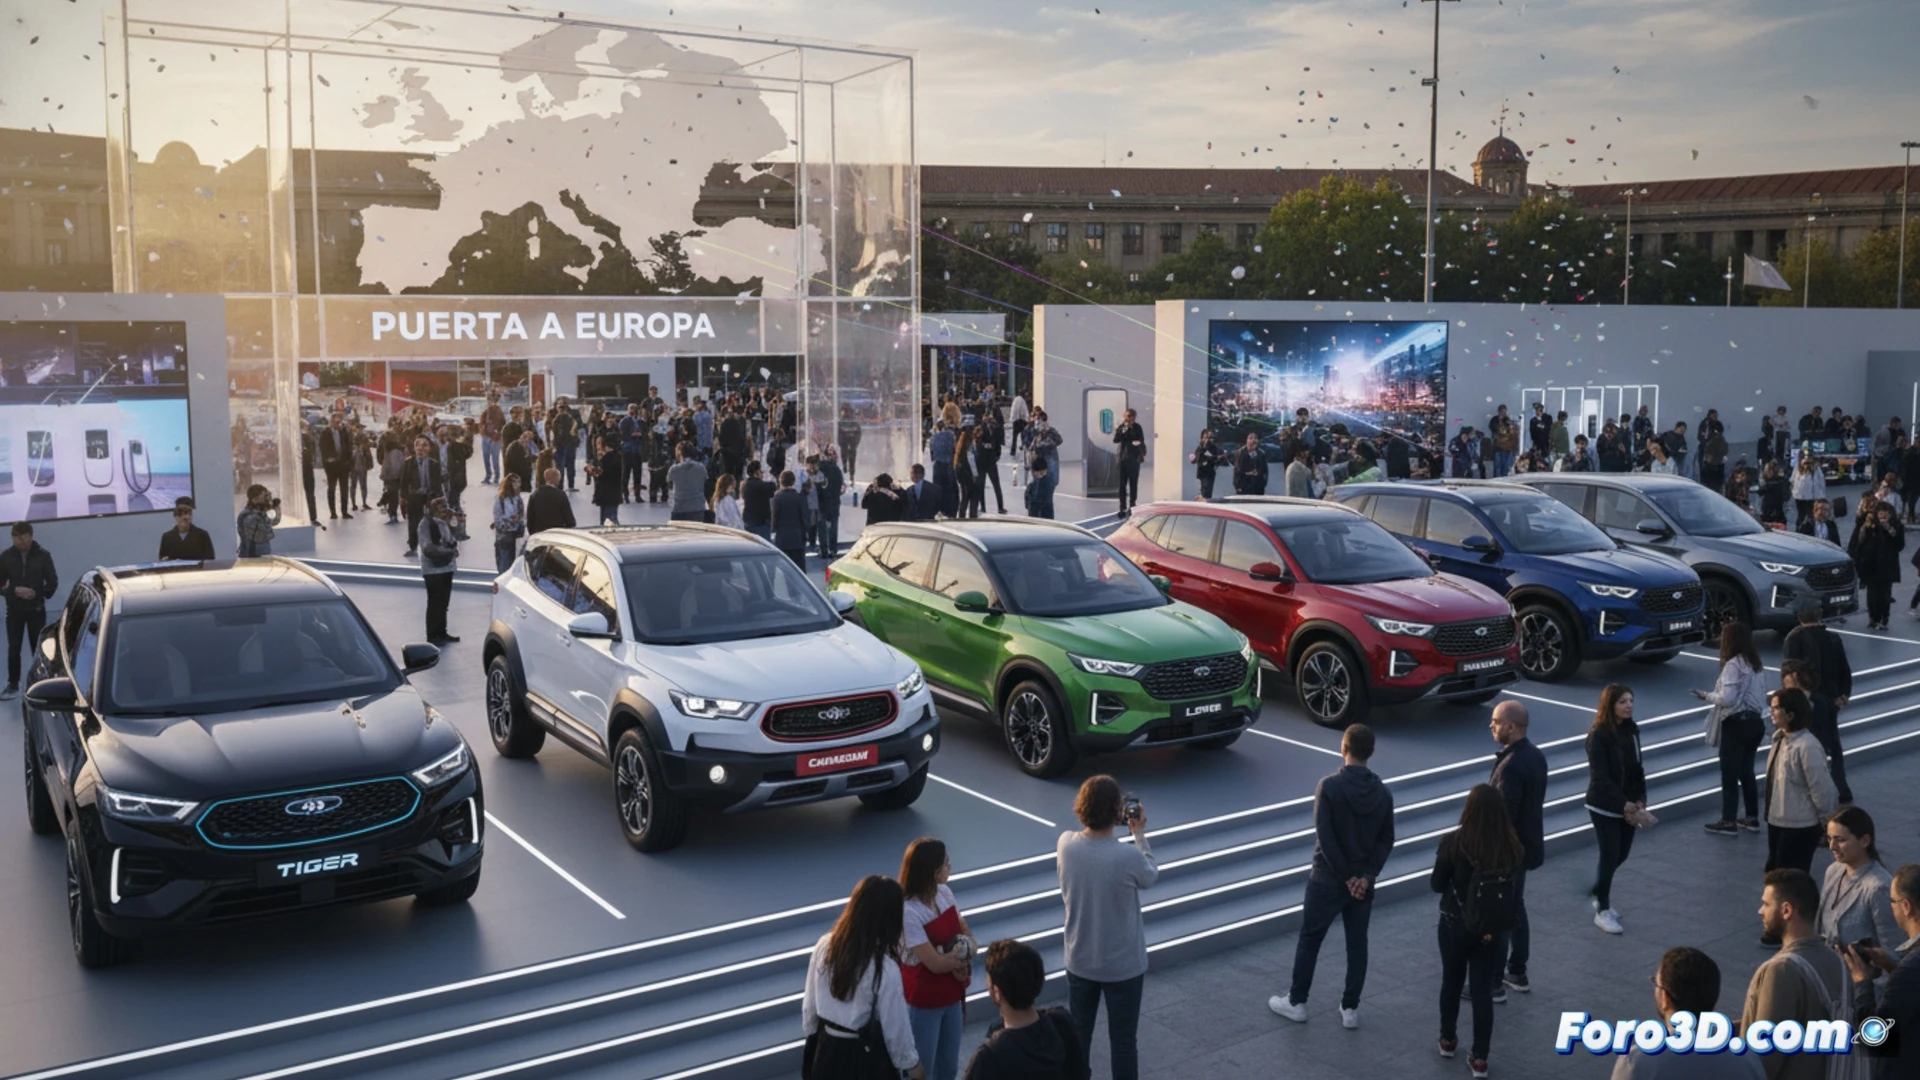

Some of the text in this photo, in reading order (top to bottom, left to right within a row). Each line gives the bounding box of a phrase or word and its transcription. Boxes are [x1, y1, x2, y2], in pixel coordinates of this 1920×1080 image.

[371, 311, 716, 340] PUERTA A EUROPA
[276, 852, 360, 878] TIGER
